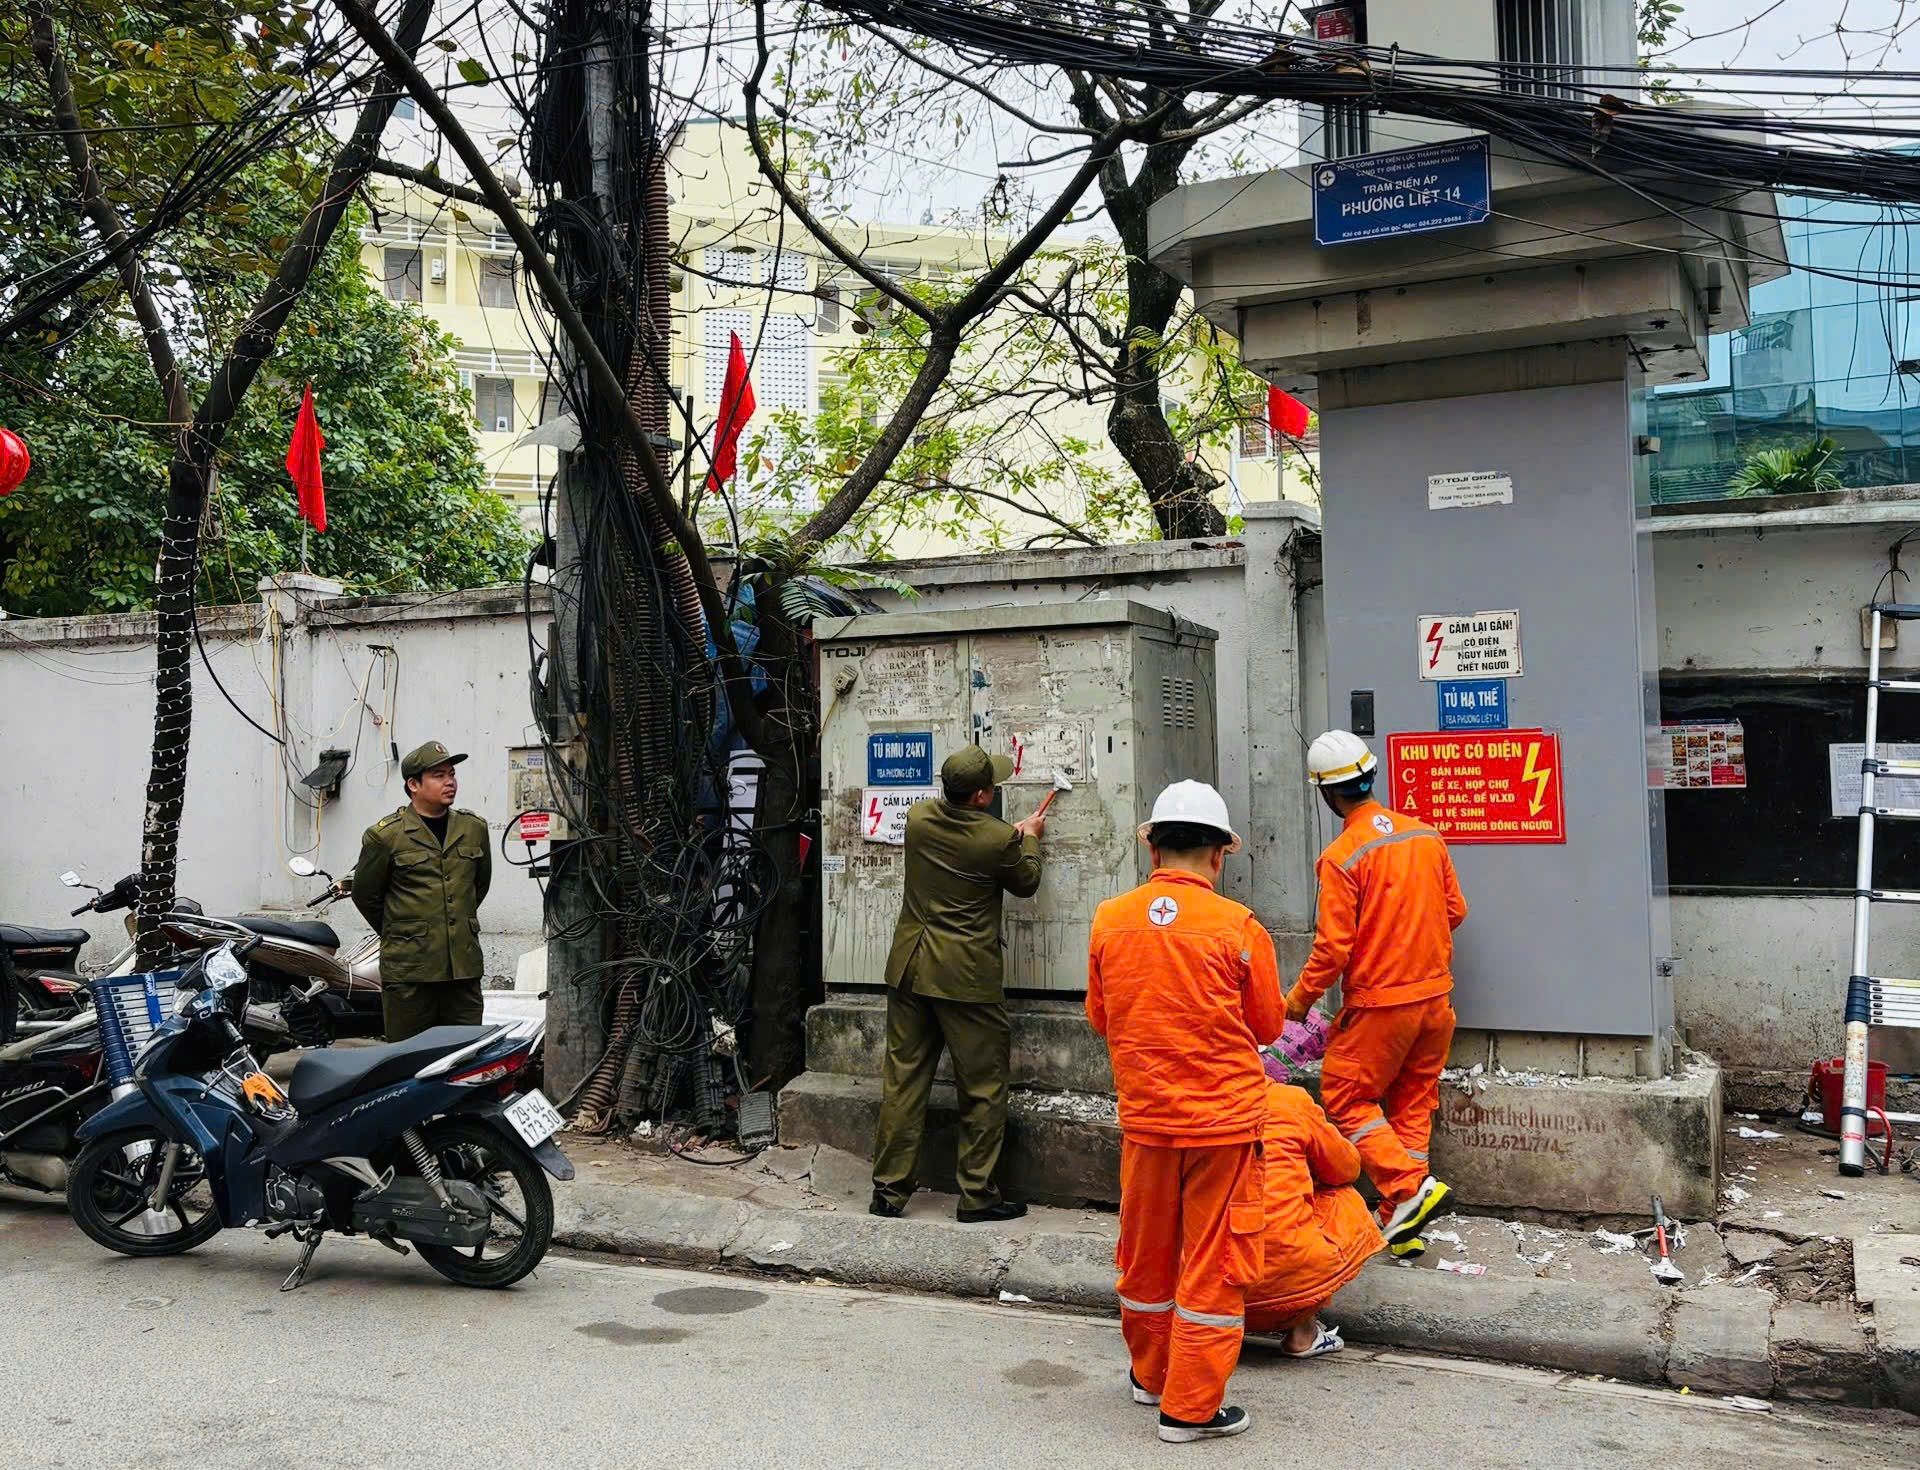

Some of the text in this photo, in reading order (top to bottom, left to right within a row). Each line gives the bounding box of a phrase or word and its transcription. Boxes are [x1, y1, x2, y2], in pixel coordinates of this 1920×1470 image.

[1356, 160, 1375, 168] CÔNG
[1385, 155, 1401, 164] ĐIỆN
[1402, 153, 1415, 162] LỰC
[1386, 164, 1402, 172] ĐIỆN
[1402, 162, 1416, 170] LỰC
[1363, 174, 1438, 195] TRẠM BIẾN ÁP
[1342, 186, 1461, 216] PHƯƠNG LIỆT 14
[1449, 620, 1470, 634] CẤM
[1473, 621, 1487, 634] LẠI
[1464, 635, 1500, 647] CÓ ĐIỆN
[822, 646, 866, 659] TOJI
[1458, 646, 1507, 660] NGUY HIỂM
[1457, 660, 1509, 672] CHẾT NGƯỜI
[1444, 686, 1500, 710] TỦ HẠ THẾ
[1456, 713, 1480, 724] PHƯƠNG
[1481, 712, 1492, 724] LIỆT
[1494, 713, 1500, 722] 14
[873, 738, 926, 759] TỦ RMU 24KV
[1400, 739, 1522, 763] KHU VỰC CÓ ĐIỆN
[886, 767, 905, 778] PHƯƠNG
[906, 766, 916, 780] LIỆT
[1430, 766, 1482, 776] BÁN HÀNG
[1431, 778, 1510, 791] ĐỂ XE, HỌP CHỢ
[883, 792, 900, 806] CẤM
[1489, 793, 1515, 803] VLXD
[896, 810, 906, 820] CÓ
[1432, 806, 1485, 818] ĐI VỆ SINH
[891, 823, 906, 831] NGU
[1433, 818, 1553, 832] TẬP TRUNG ĐÔNG NGƯỜI
[1, 1080, 45, 1098] LEAD
[523, 1109, 560, 1143] 173.30
